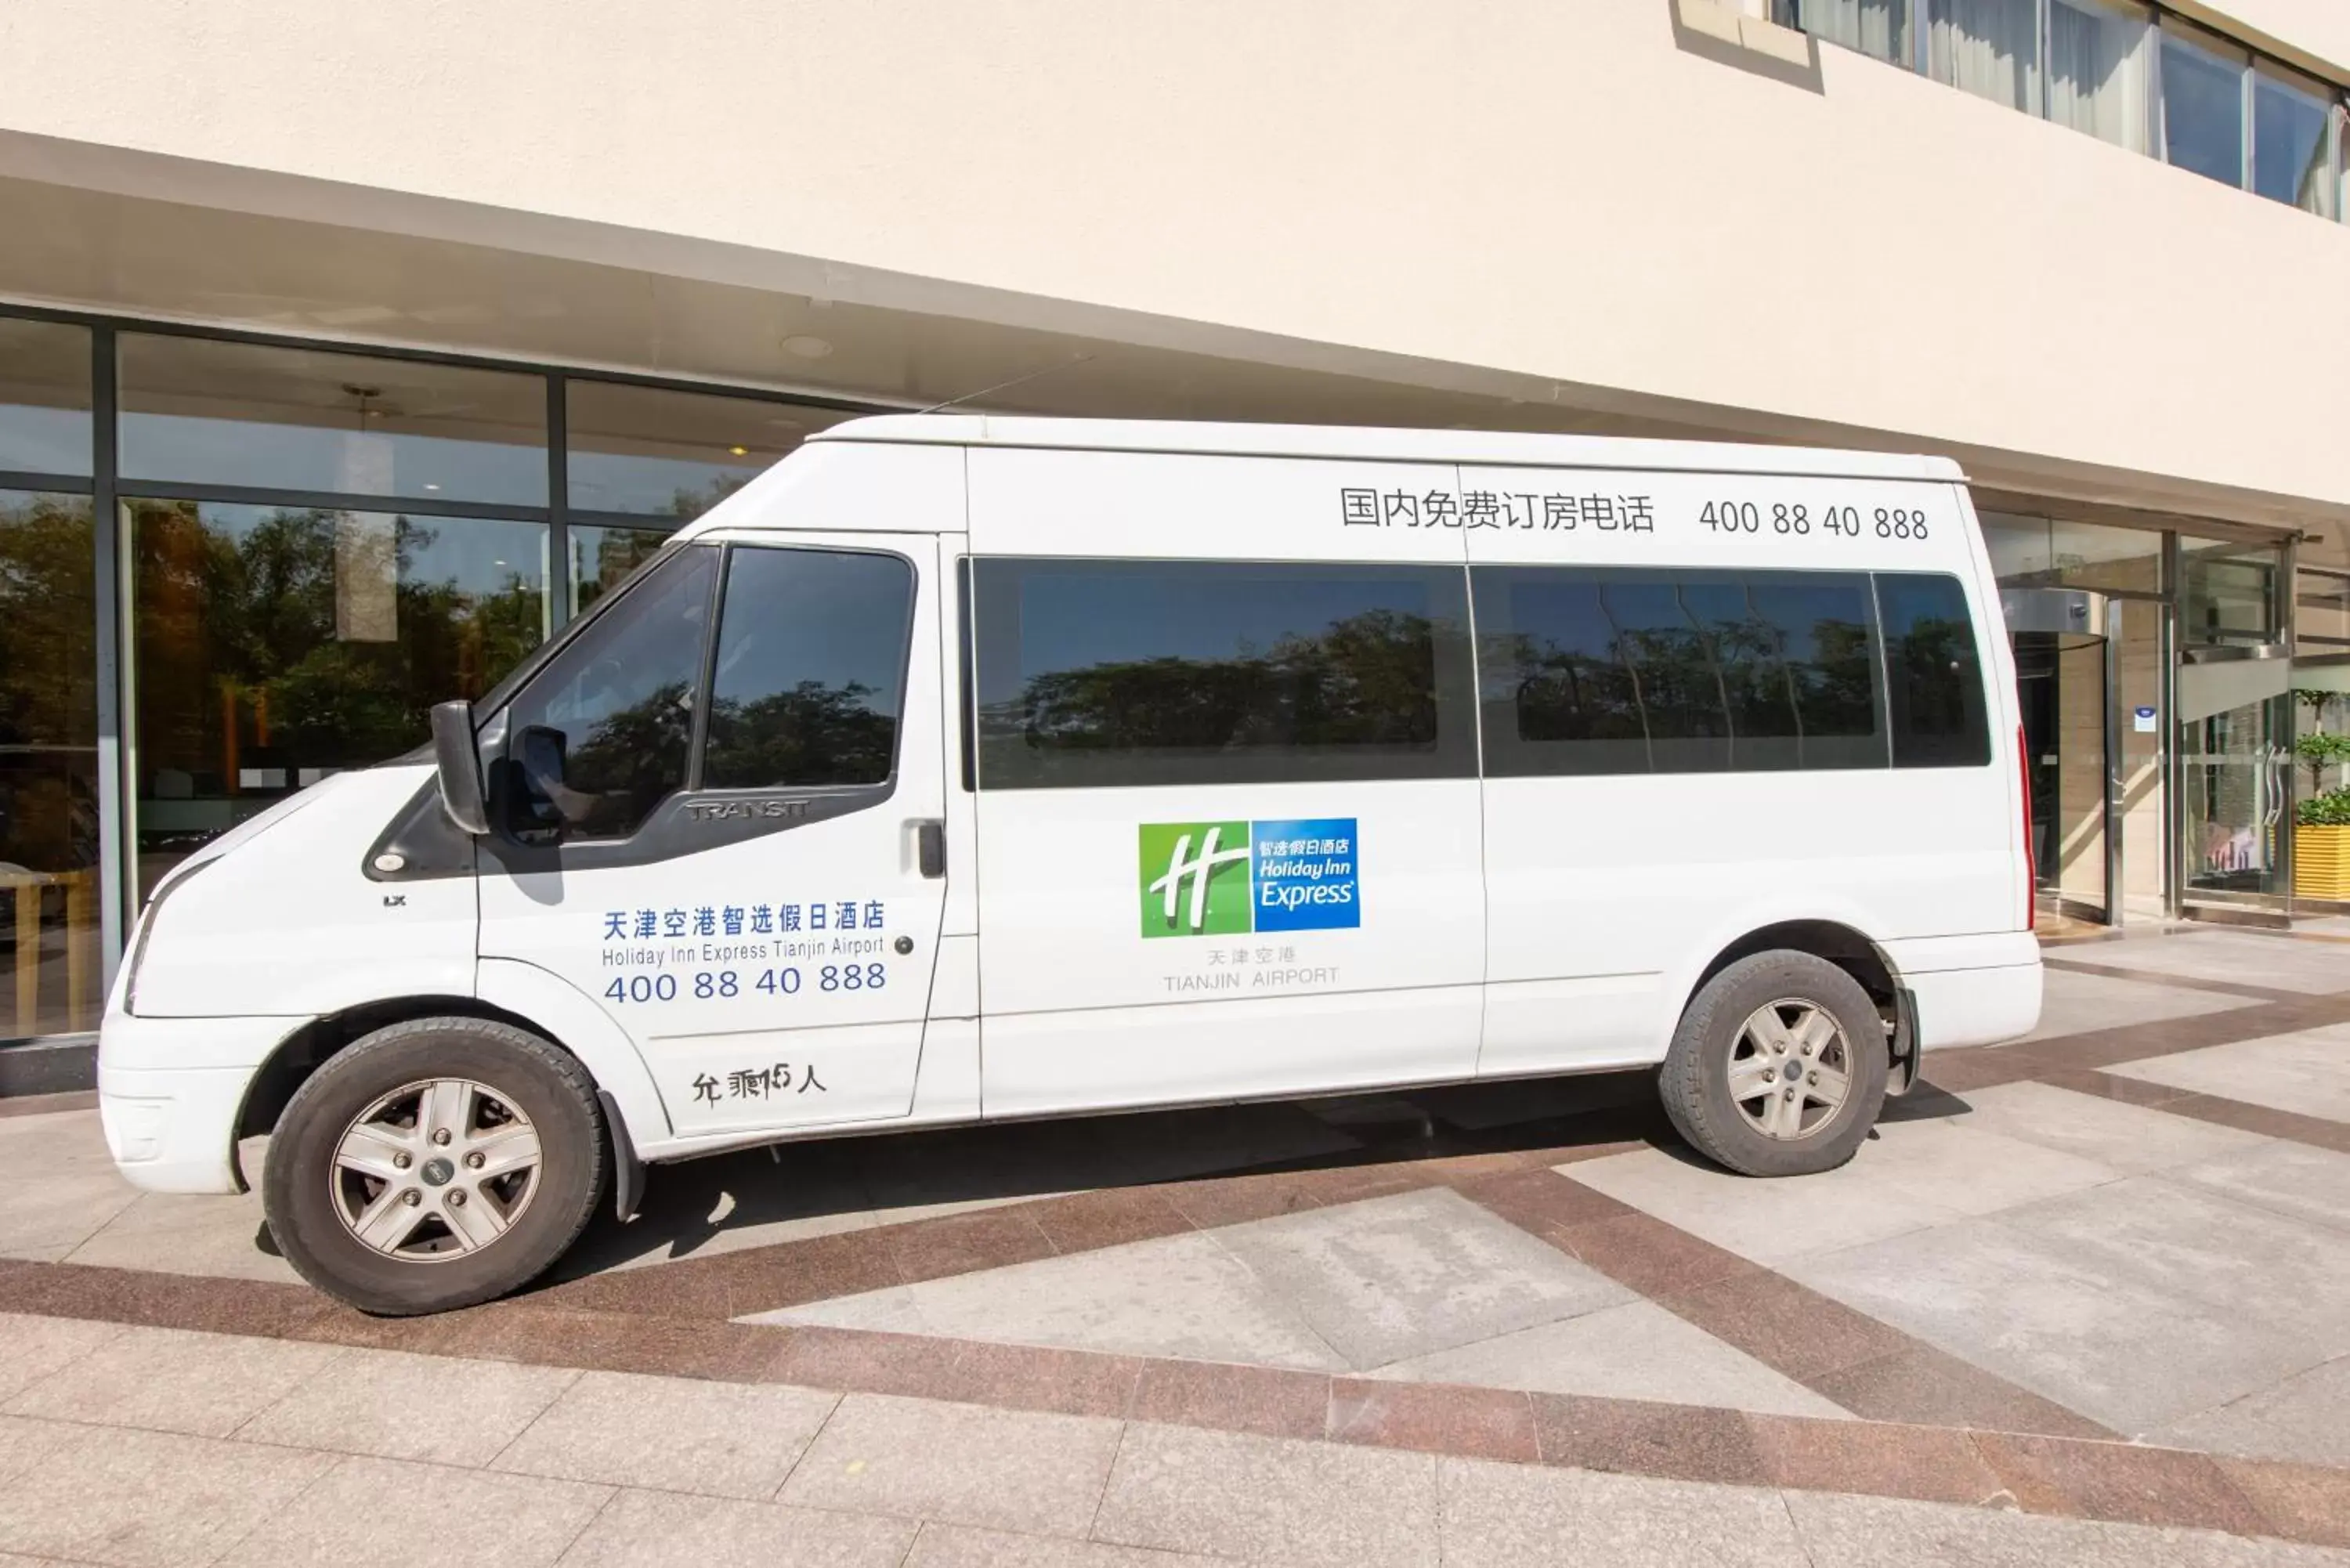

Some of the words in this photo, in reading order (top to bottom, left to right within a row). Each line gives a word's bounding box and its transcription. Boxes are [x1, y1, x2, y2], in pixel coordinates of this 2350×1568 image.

[1340, 487, 1654, 533] 国内免费订房电话
[1699, 500, 1759, 533] 400
[1772, 503, 1810, 535] 88
[1823, 505, 1860, 537] 40
[1874, 508, 1929, 540] 888
[685, 800, 811, 821] TRANSIT
[1260, 858, 1323, 880] Holiday
[1325, 858, 1351, 875] Inn
[1261, 880, 1354, 912] Express
[604, 898, 884, 941] 天津空港智选假日酒店
[602, 947, 665, 969] Holiday
[671, 945, 696, 963] Inn
[703, 942, 767, 964] Express
[774, 939, 825, 960] Tianjin
[832, 936, 884, 957] Airport
[1209, 946, 1296, 966] 天津空港
[604, 974, 677, 1003] 400
[694, 970, 739, 999] 88
[755, 967, 801, 995] 40
[819, 963, 885, 992] 888
[1163, 972, 1240, 992] TIANJIN
[1253, 966, 1340, 987] AIRPORT
